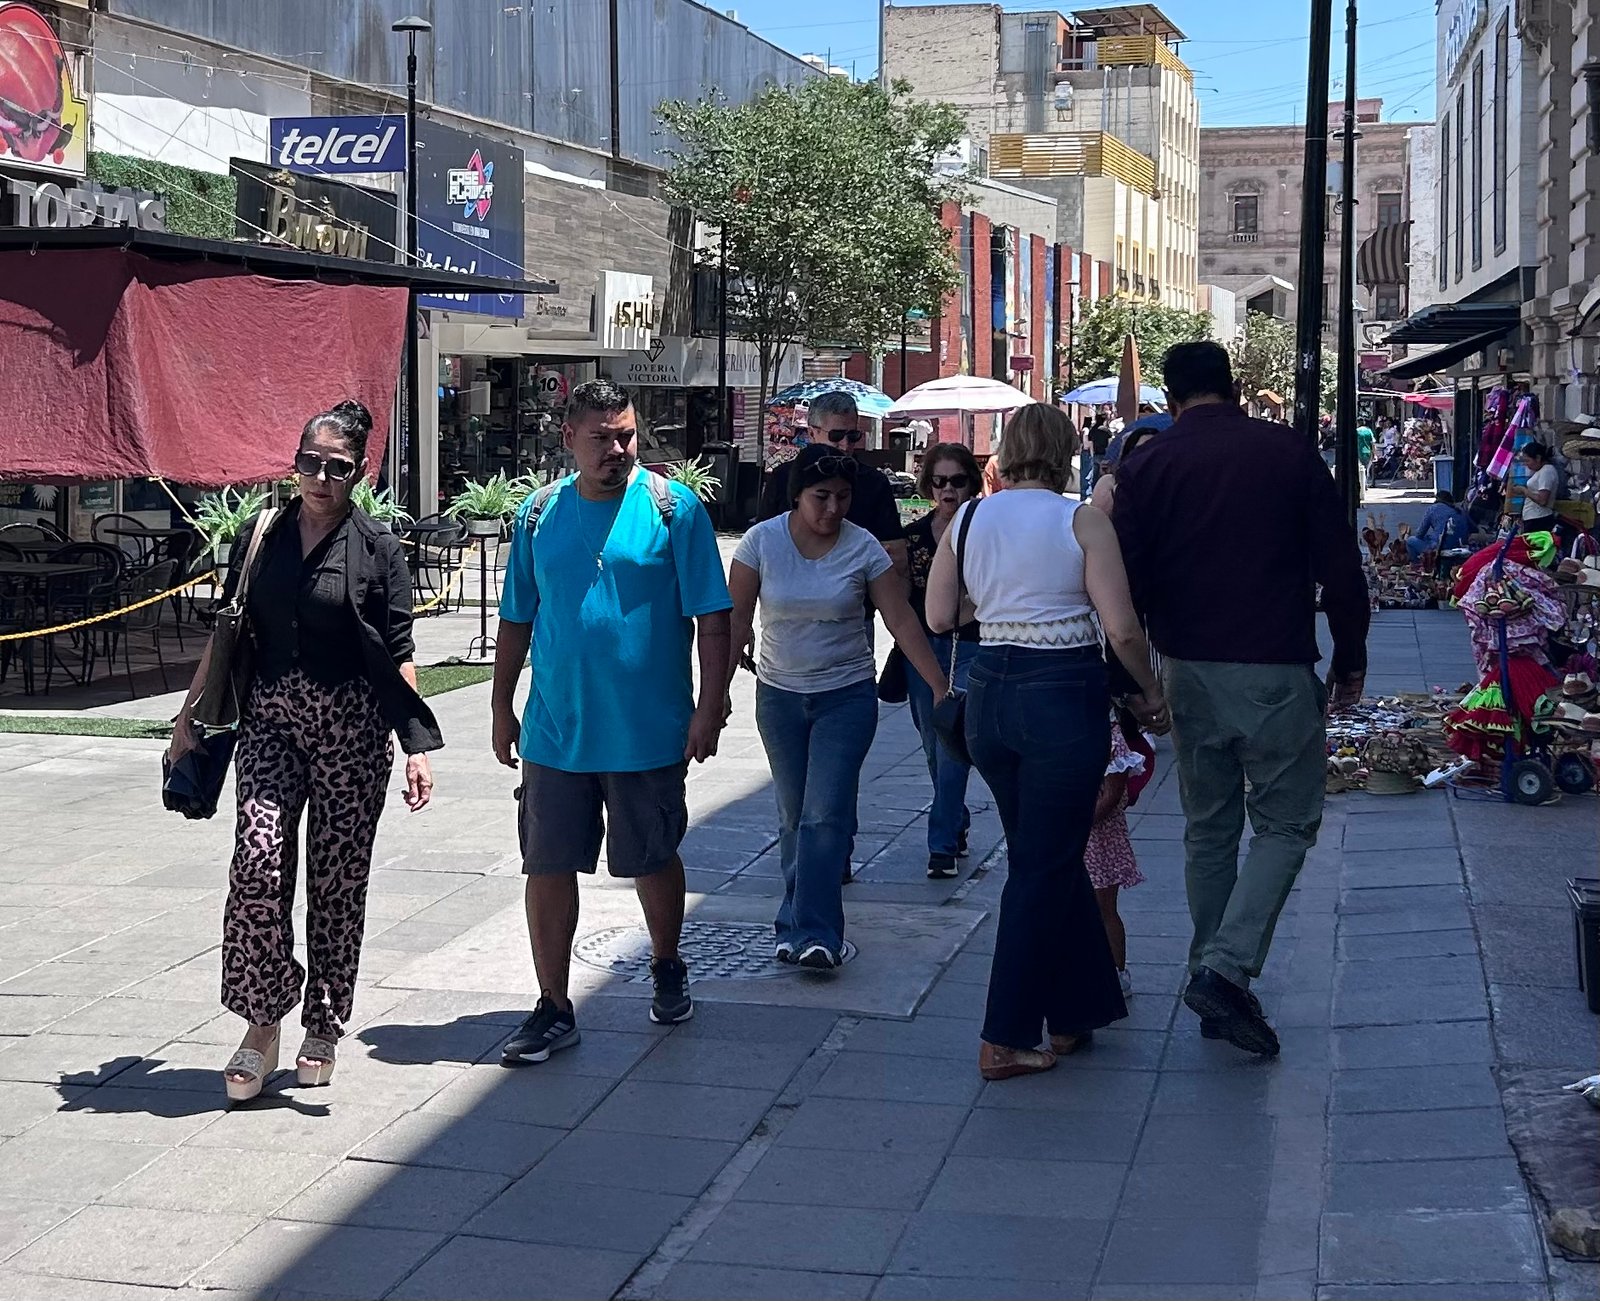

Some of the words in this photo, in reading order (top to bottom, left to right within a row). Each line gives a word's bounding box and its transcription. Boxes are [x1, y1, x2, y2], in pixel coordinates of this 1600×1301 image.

[279, 126, 397, 165] telcel
[7, 181, 166, 233] TORTAS
[628, 373, 678, 383] VICTORIA
[629, 363, 676, 372] JOYERIA
